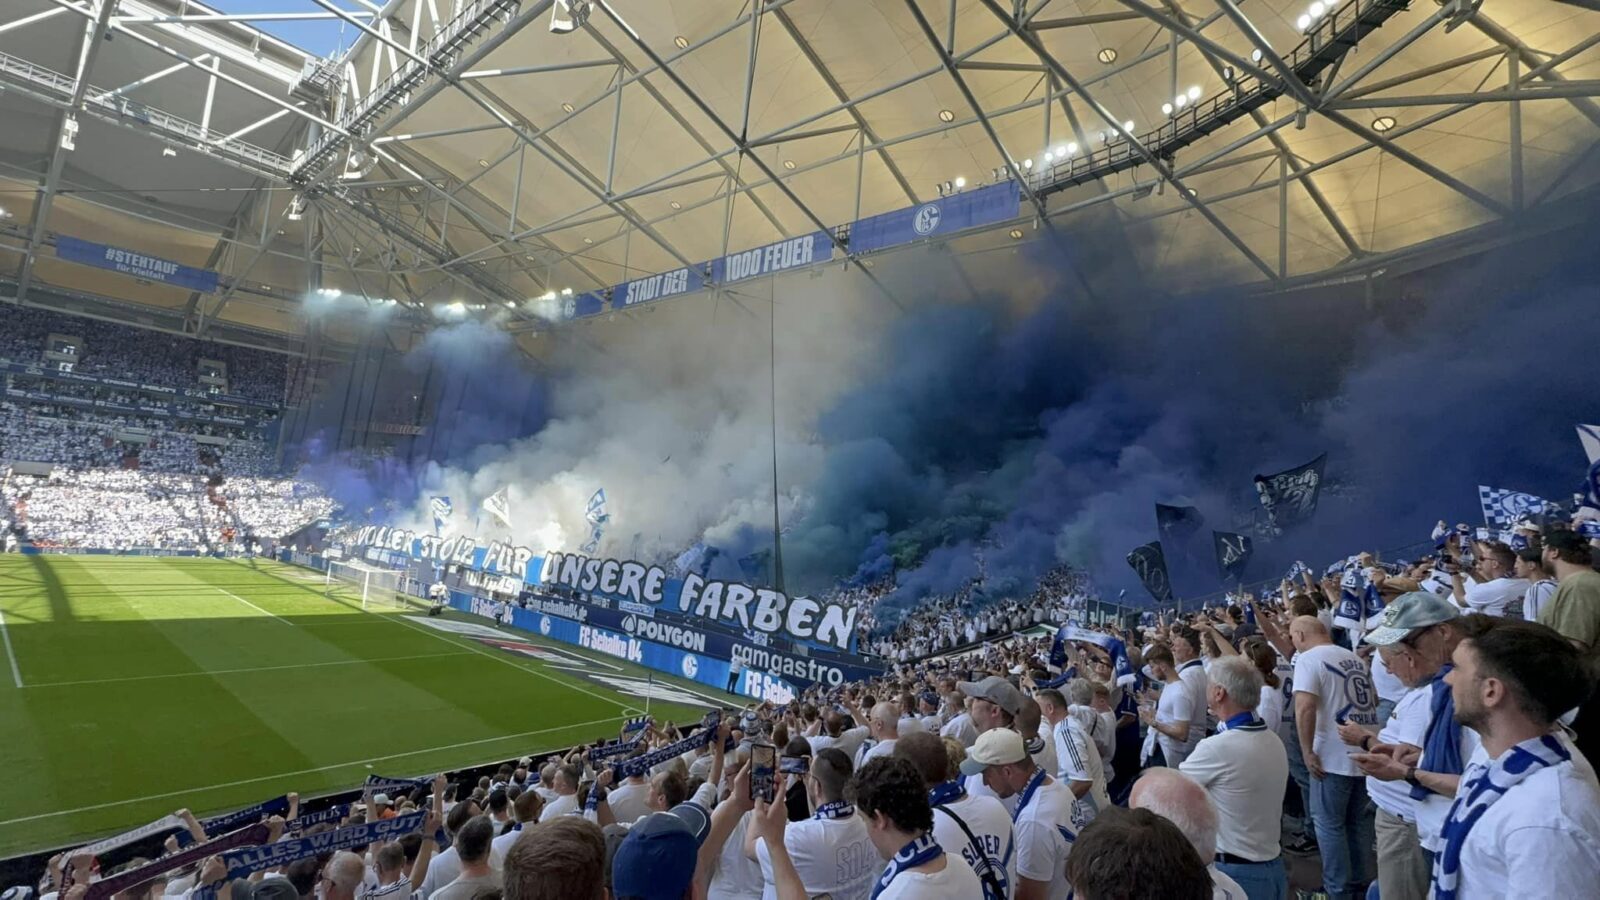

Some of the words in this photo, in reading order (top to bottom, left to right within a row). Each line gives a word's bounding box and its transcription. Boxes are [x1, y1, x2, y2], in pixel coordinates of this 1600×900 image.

[105, 248, 179, 275] #STEHTAUF
[132, 267, 165, 280] Vielfalt
[726, 252, 761, 282] 1000
[763, 235, 814, 273] FEUER
[625, 276, 662, 304] STADT
[662, 268, 689, 296] DER
[357, 525, 416, 556] VOLLER
[420, 534, 477, 565] STOLZ
[482, 537, 533, 582] FÜR
[540, 551, 666, 605] UNSERE
[678, 572, 858, 650] FARBEN
[579, 625, 591, 648] FC
[591, 628, 627, 659] Schalke
[627, 639, 643, 662] 04
[637, 619, 706, 652] POLYGON
[745, 670, 762, 698] FC
[227, 840, 302, 871] ALLES
[309, 825, 370, 850] WIRD
[374, 815, 421, 833] GUT
[961, 834, 1001, 867] SUPER
